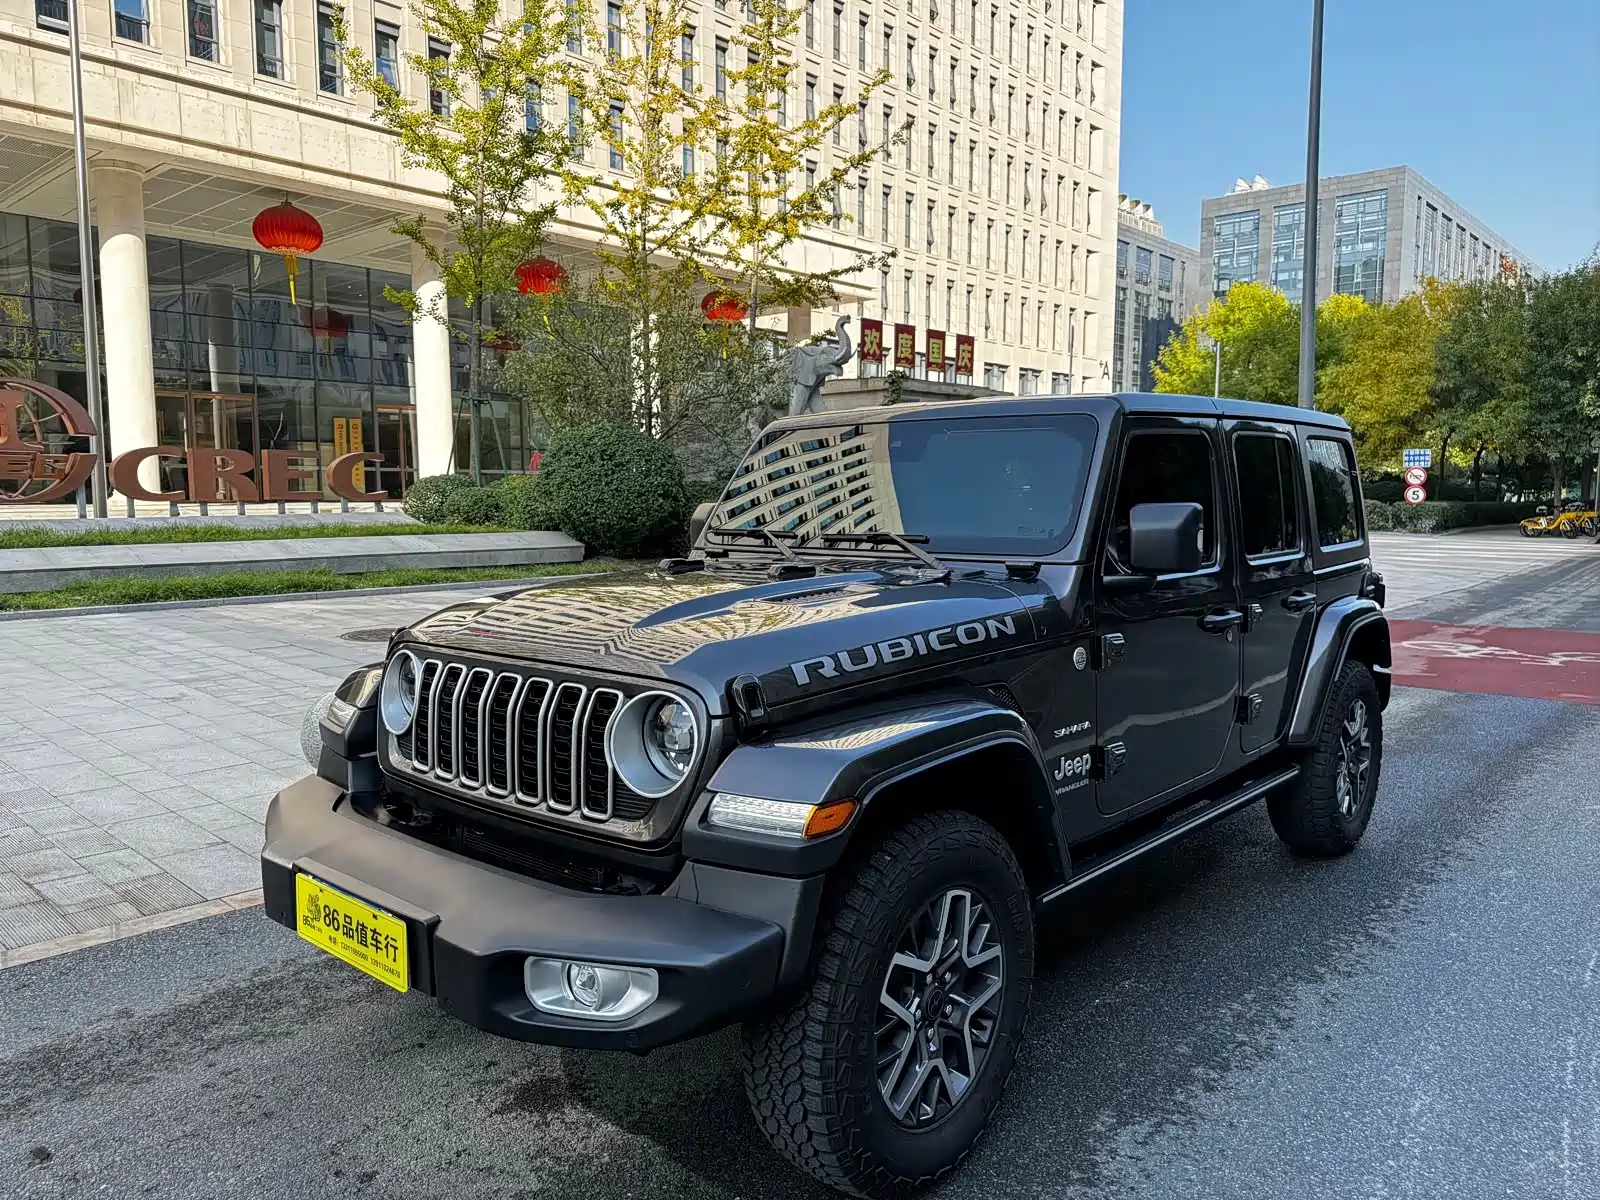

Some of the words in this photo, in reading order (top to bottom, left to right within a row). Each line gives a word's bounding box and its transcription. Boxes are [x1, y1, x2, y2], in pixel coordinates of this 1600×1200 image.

[864, 328, 973, 367] 欢度国庆
[109, 446, 388, 501] CREC
[1411, 490, 1420, 501] 5
[790, 615, 1016, 685] RUBICON
[1054, 721, 1091, 738] SAHARA
[1054, 754, 1091, 780] Jeep
[1055, 779, 1088, 795] WRANGLER
